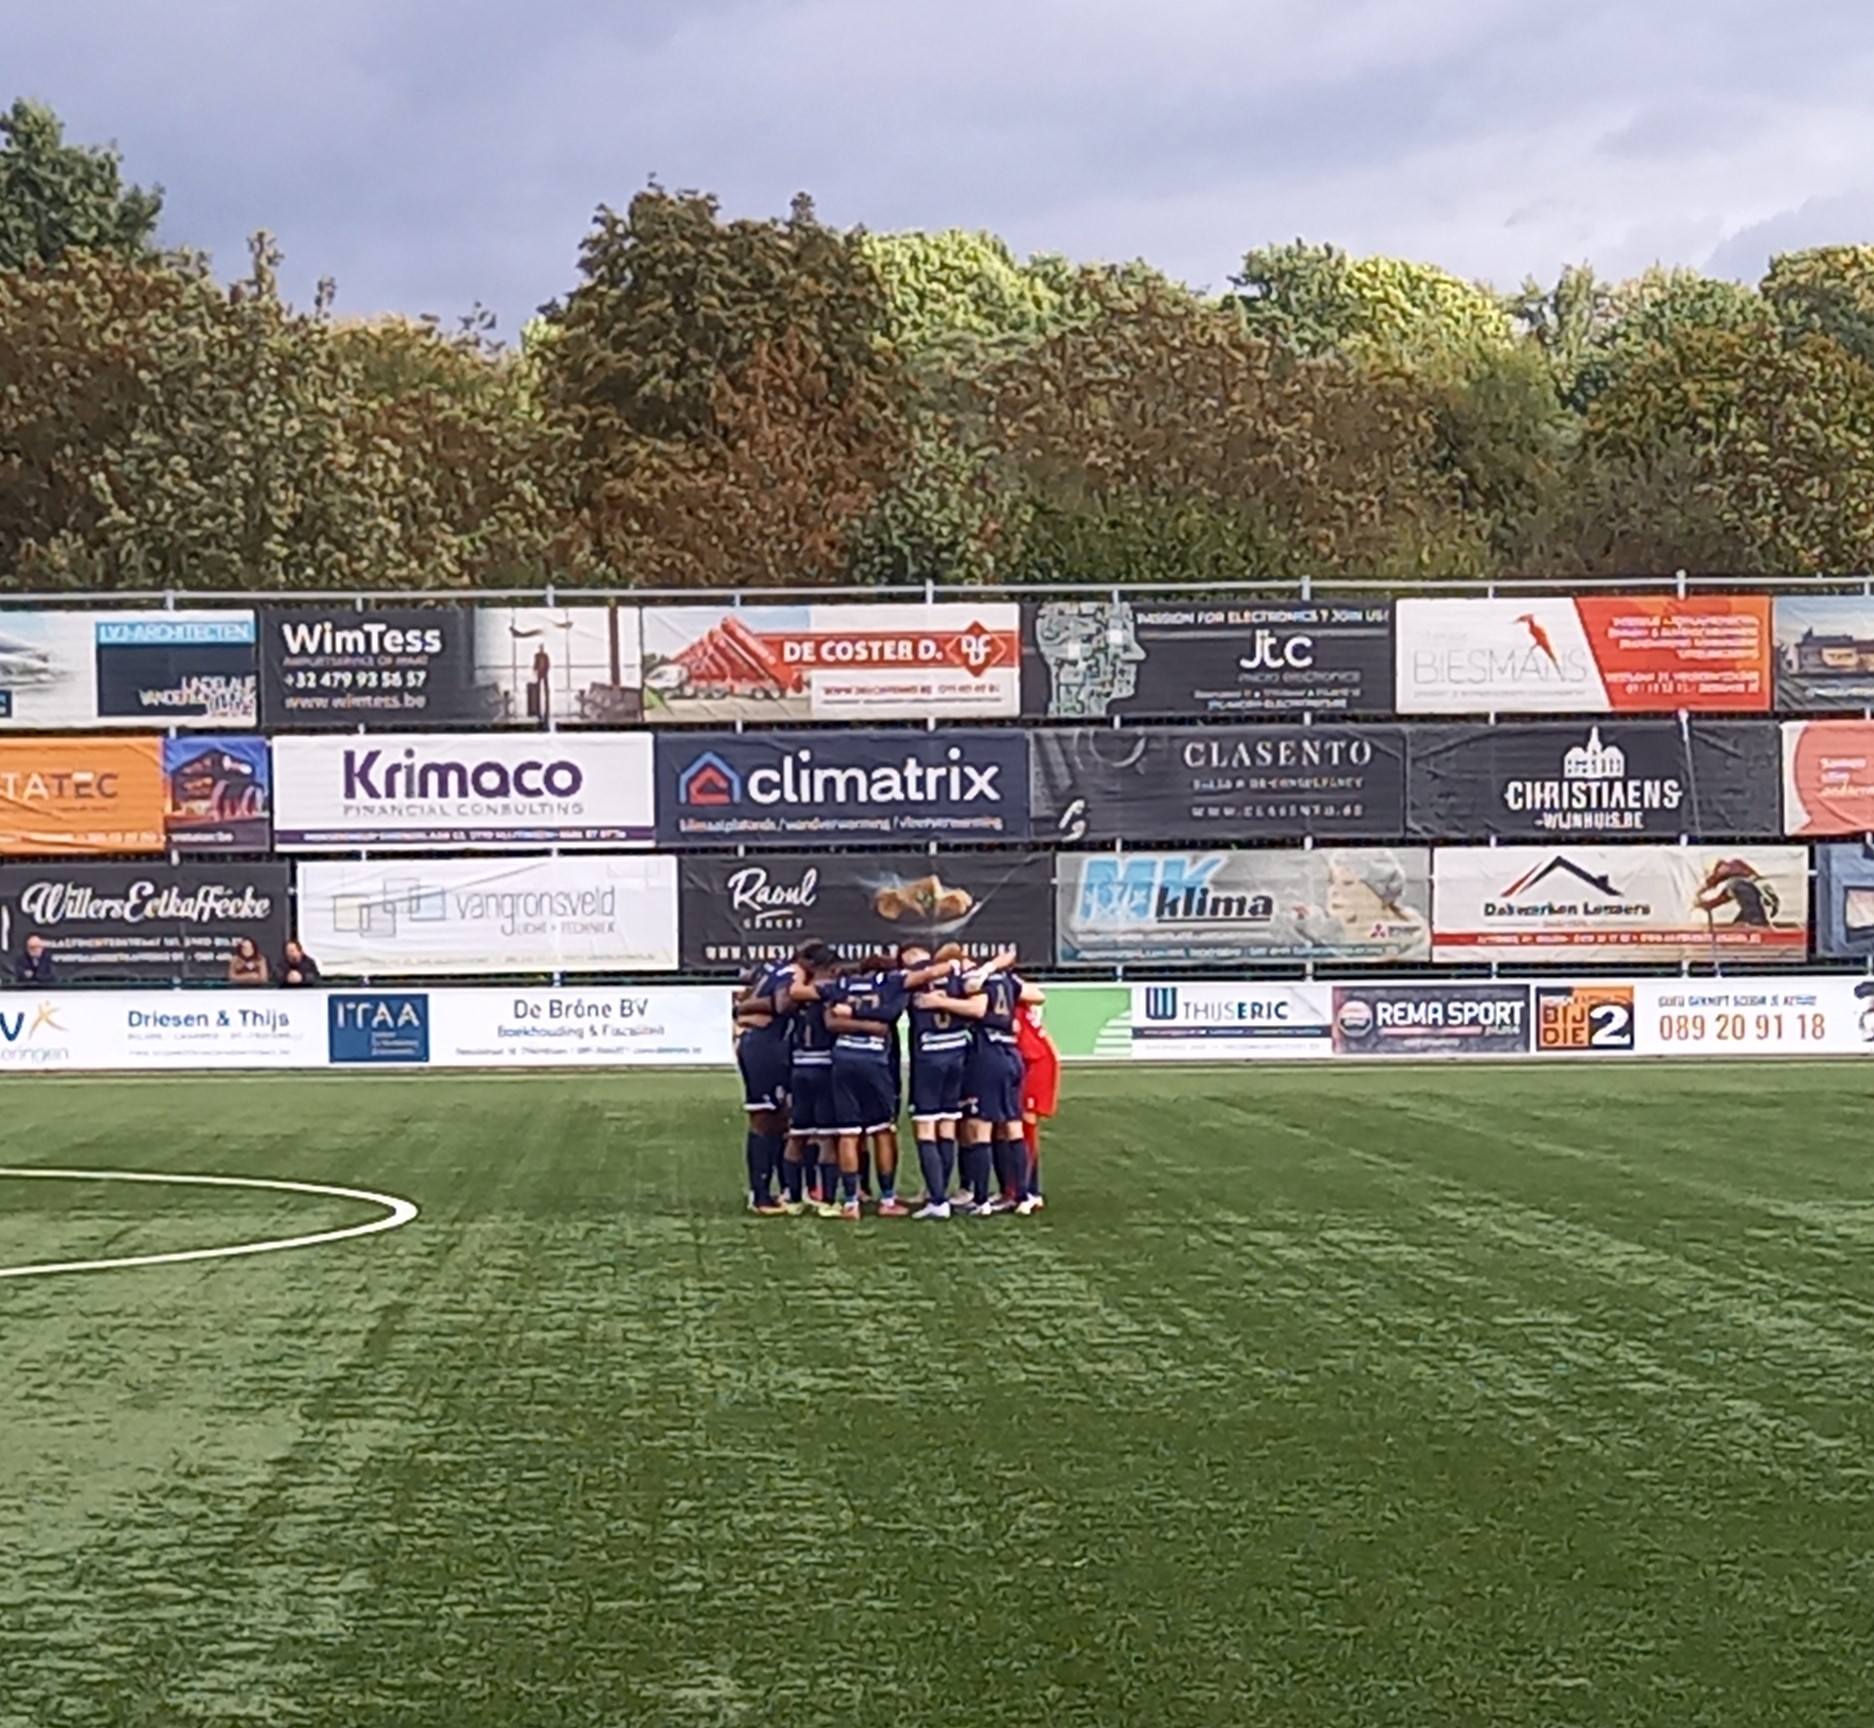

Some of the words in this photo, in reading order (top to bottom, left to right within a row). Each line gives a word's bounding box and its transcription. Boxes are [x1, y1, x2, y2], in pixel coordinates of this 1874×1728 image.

[282, 621, 442, 654] WimTess
[784, 641, 816, 661] DE
[820, 640, 913, 661] COSTER
[918, 639, 943, 661] D.
[1184, 741, 1371, 768] CLASENTO
[343, 748, 583, 799] Krimaco
[748, 747, 1000, 802] climatrix
[1504, 779, 1683, 810] CHRISTIAENS
[343, 803, 449, 817] FINANCIAL
[457, 802, 584, 816] CONSULTING
[727, 868, 818, 912] Raoul
[1155, 885, 1274, 918] klima
[128, 1010, 209, 1028] Driesen
[216, 1009, 231, 1027] &
[238, 1008, 290, 1033] Thijs
[513, 999, 542, 1019] De
[620, 998, 649, 1017] BV
[1376, 1003, 1443, 1026] REMA
[1448, 1001, 1525, 1026] SPORT
[1590, 1005, 1631, 1045] 2
[1660, 1015, 1706, 1040] 089
[1716, 1014, 1745, 1040] 20
[1756, 1014, 1783, 1040] 91
[1797, 1013, 1826, 1040] 18
